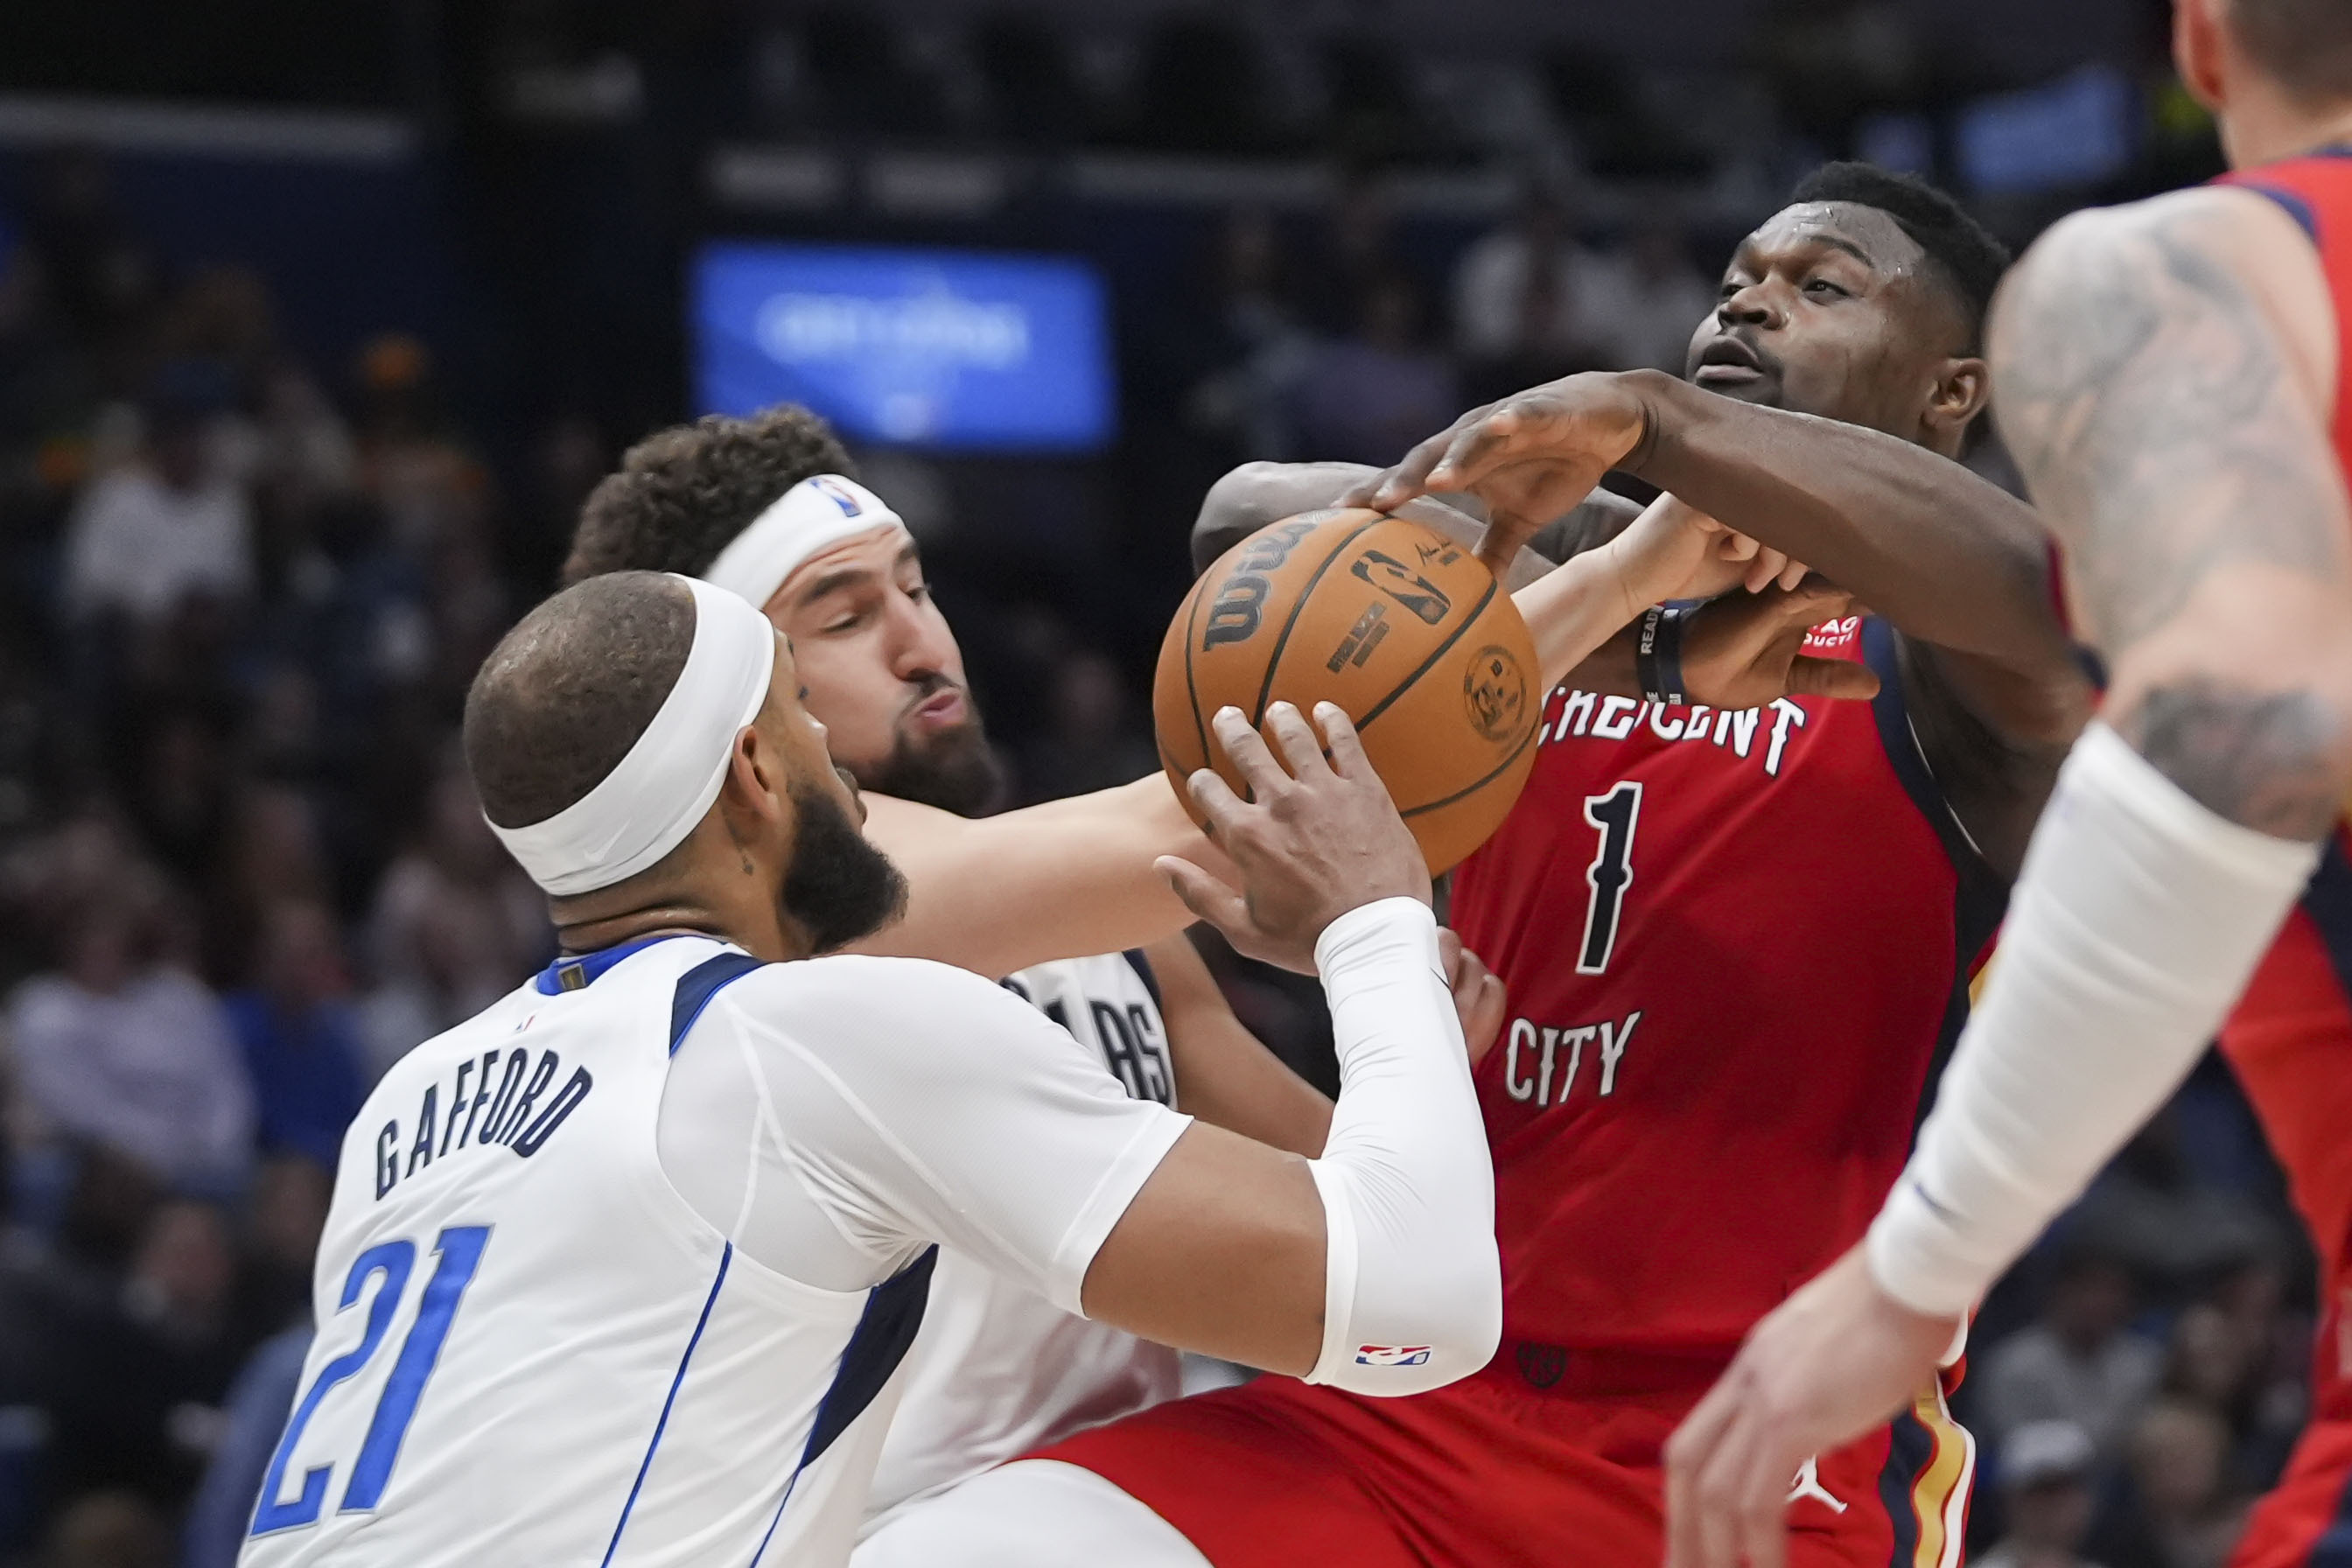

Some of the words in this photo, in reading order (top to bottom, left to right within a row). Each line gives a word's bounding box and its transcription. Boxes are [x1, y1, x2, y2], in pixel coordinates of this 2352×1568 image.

[1575, 780, 1642, 975] 1
[376, 1046, 593, 1201] GAFFORD
[1504, 1011, 1642, 1107] CITY
[248, 1222, 496, 1541] 21
